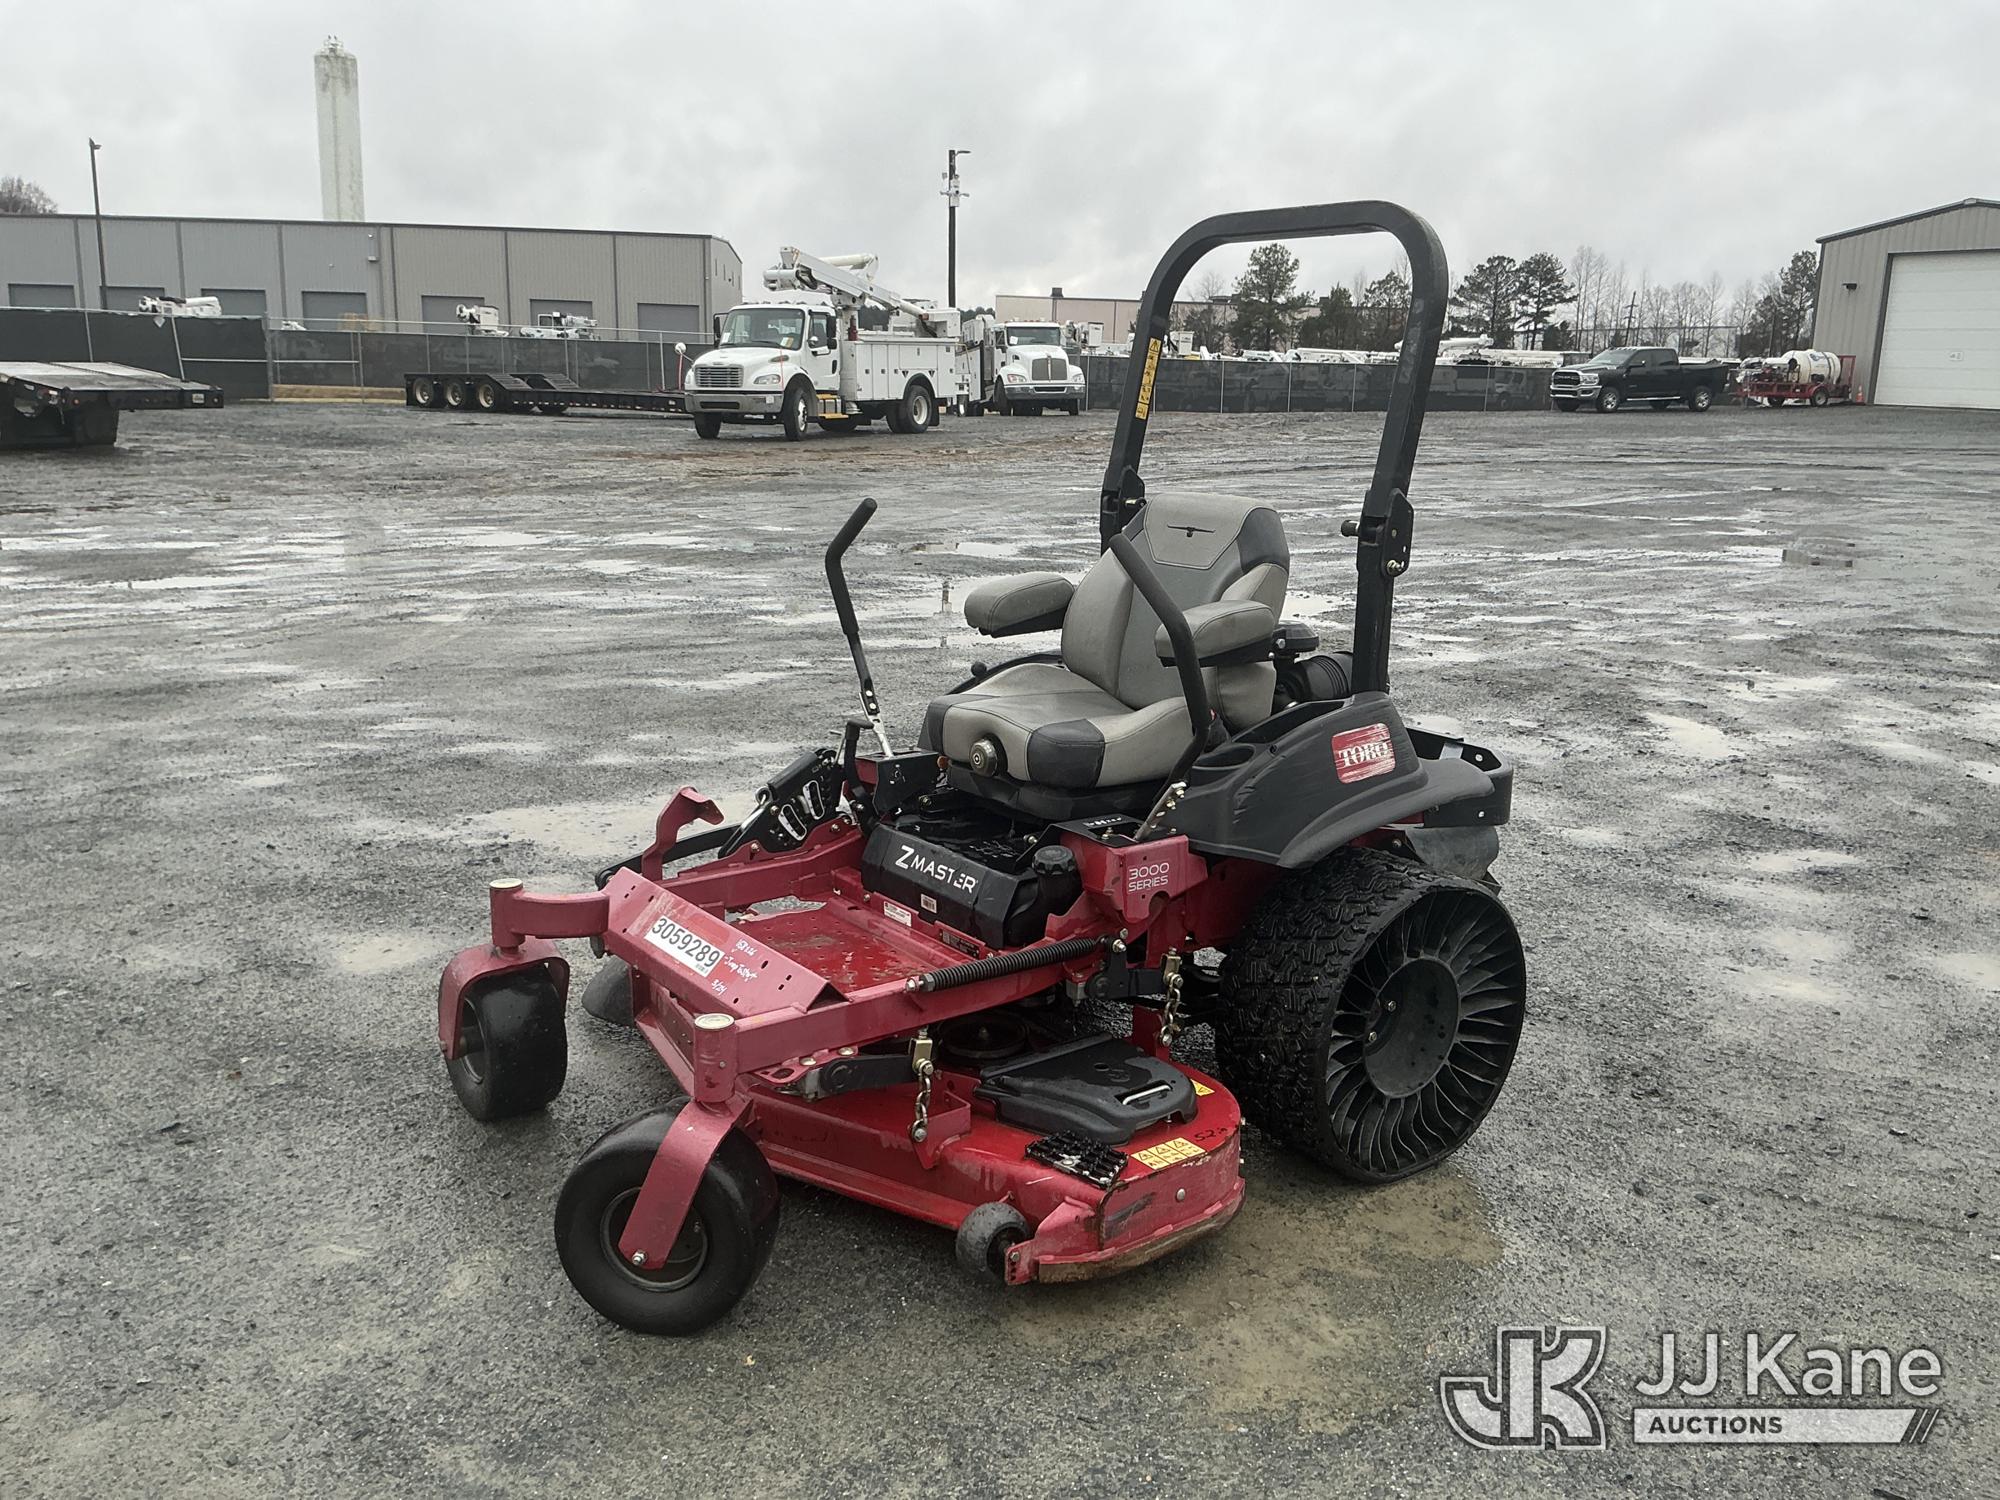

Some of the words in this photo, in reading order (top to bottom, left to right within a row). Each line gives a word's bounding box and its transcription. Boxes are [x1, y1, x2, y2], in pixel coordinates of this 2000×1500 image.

[1128, 862, 1170, 881] 3000
[1128, 875, 1169, 892] SERIES
[651, 917, 721, 968] 3059289
